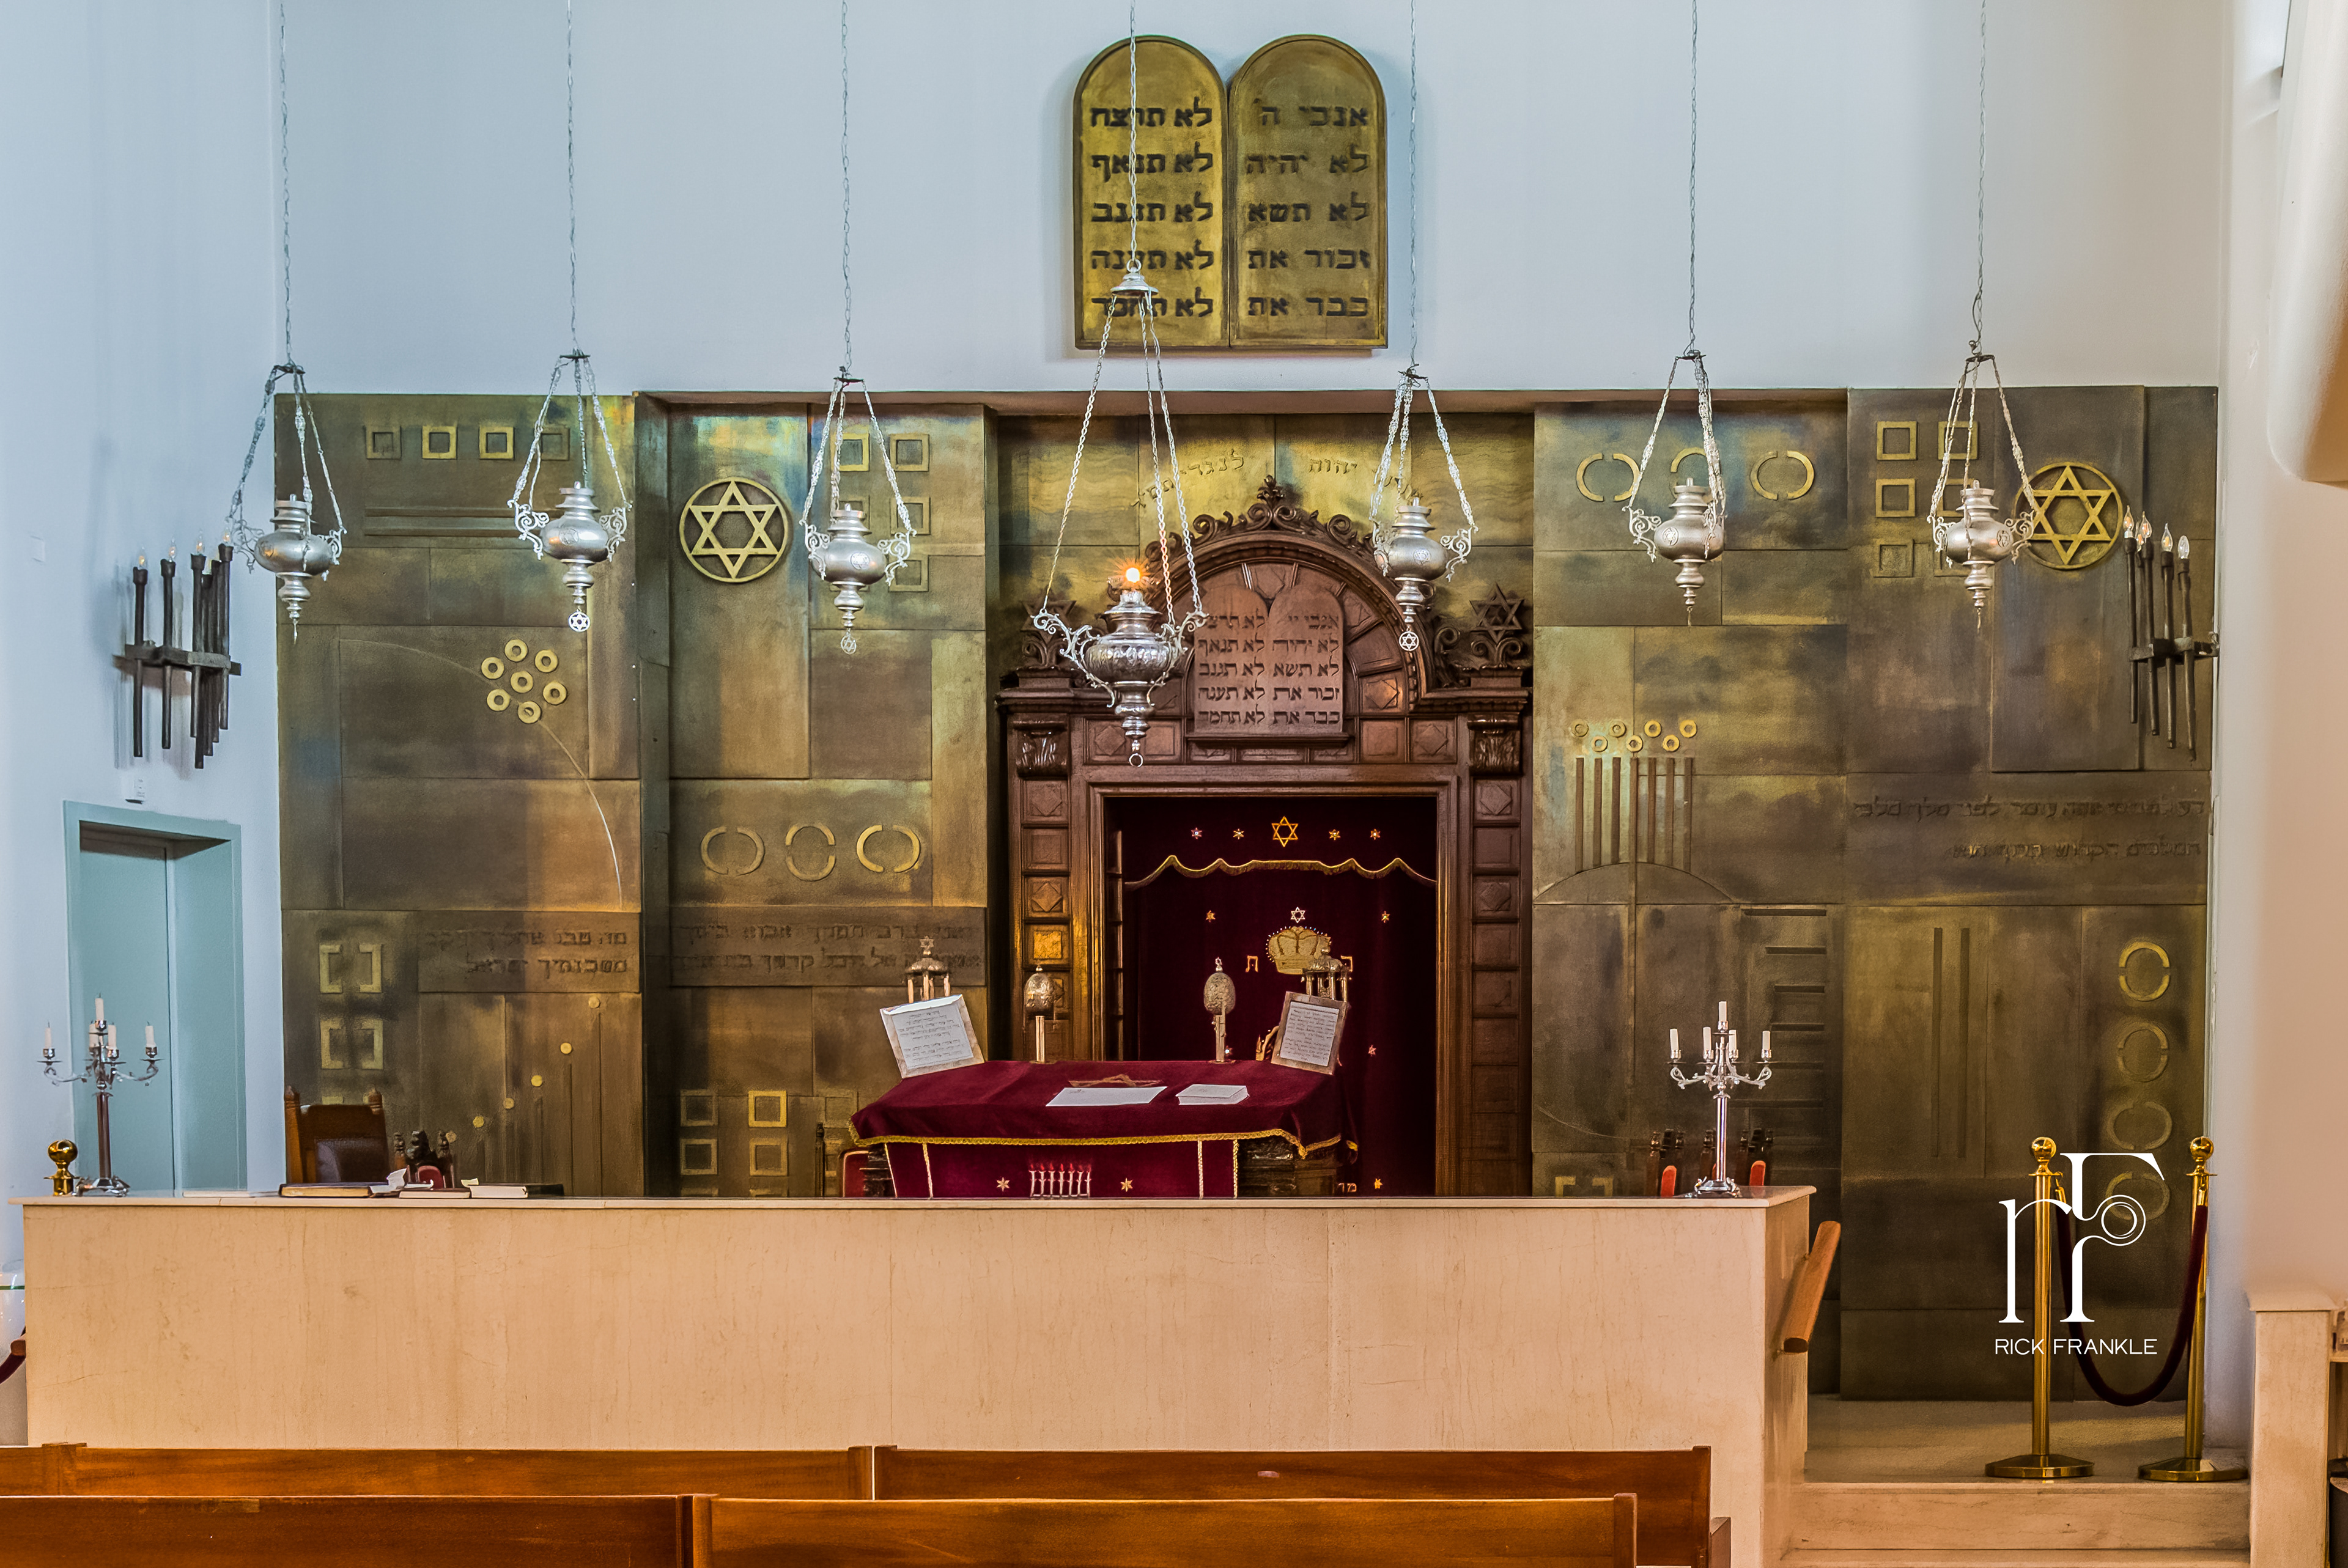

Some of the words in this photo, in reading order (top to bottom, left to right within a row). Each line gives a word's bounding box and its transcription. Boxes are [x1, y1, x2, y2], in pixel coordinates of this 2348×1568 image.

[1090, 108, 1165, 127] תרצח
[1174, 96, 1213, 127] לא
[1299, 106, 1368, 127] אנכי
[1174, 141, 1213, 173] לא
[1246, 155, 1309, 174] יהיה
[1329, 144, 1370, 174] לא
[1174, 190, 1213, 223] לא
[1248, 202, 1312, 223] תשא
[1329, 191, 1370, 222] לא
[1174, 238, 1214, 270] לא
[1248, 249, 1288, 269] את
[1304, 249, 1370, 269] זכור
[1175, 286, 1214, 317] לא
[1248, 296, 1289, 317] את
[1305, 296, 1368, 317] כבד
[1242, 608, 1265, 629] לא
[1198, 639, 1239, 657] תנאף
[1242, 632, 1265, 653] לא
[1316, 633, 1340, 653] לא
[1242, 656, 1265, 676] לא
[1272, 663, 1313, 677] תשא
[1316, 655, 1340, 677] לא
[1198, 686, 1239, 701] תענה
[1242, 679, 1266, 700] לא
[1272, 686, 1302, 701] את
[1308, 687, 1340, 701] זכור
[1198, 710, 1241, 725] תחמד
[1243, 704, 1266, 724] לא
[1272, 711, 1301, 725] את
[1305, 711, 1340, 724] כבד
